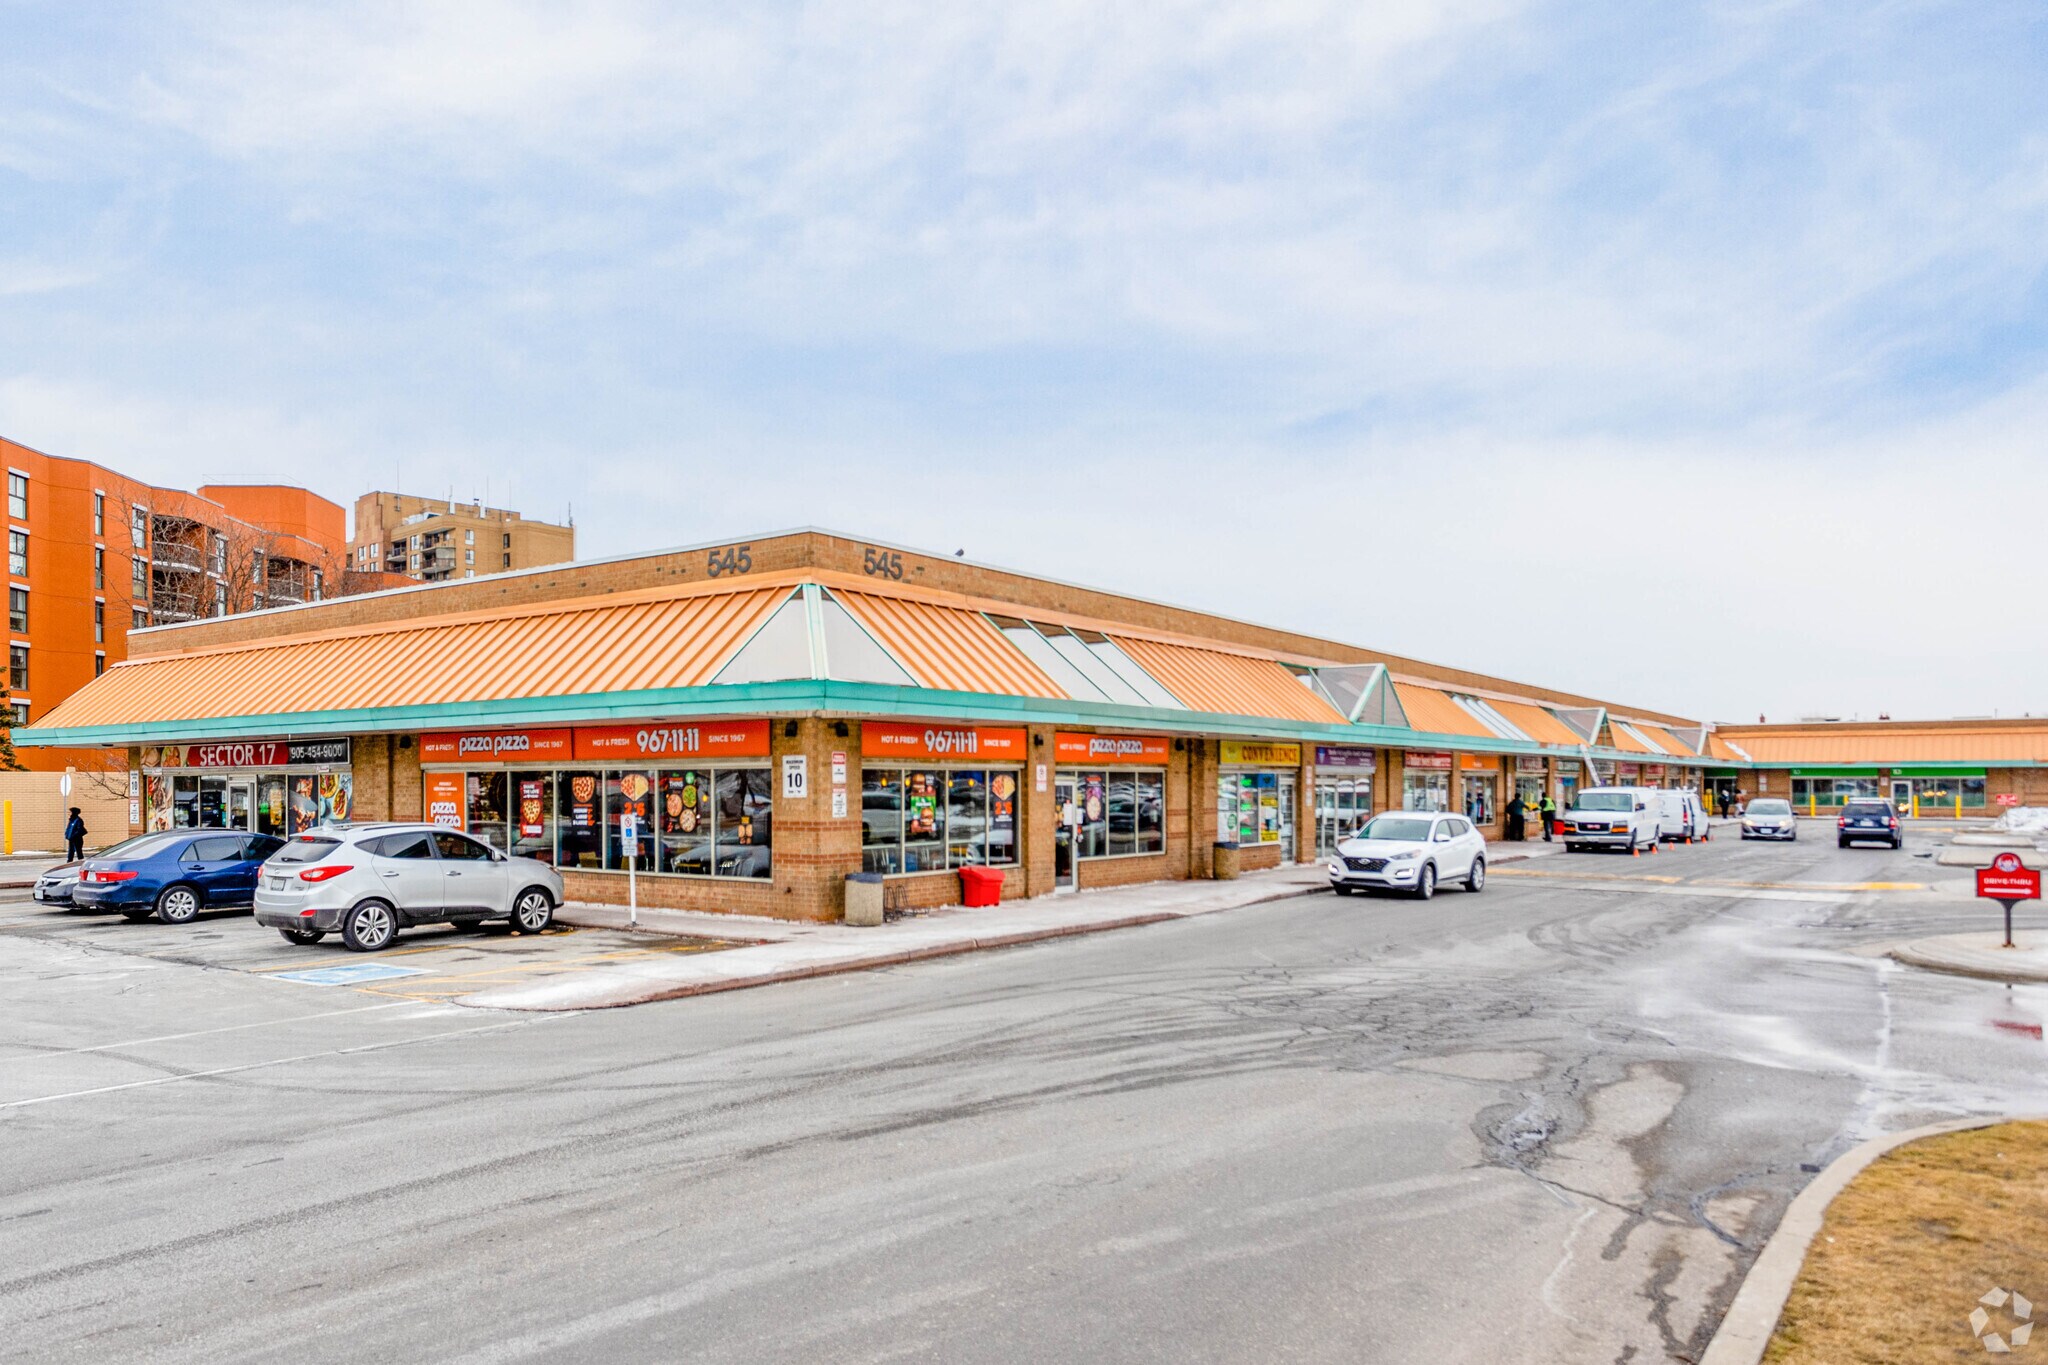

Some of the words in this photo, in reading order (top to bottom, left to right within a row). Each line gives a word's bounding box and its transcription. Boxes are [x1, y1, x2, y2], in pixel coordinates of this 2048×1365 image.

[707, 546, 752, 577] 545
[864, 548, 903, 580] 545
[459, 737, 492, 757] pizza
[494, 735, 529, 756] pizza
[534, 741, 550, 749] SINCE
[708, 735, 728, 743] SINCE
[730, 734, 745, 742] 1967
[1089, 738, 1116, 758] pizza
[1117, 740, 1142, 758] pizza
[200, 745, 254, 766] SECTOR
[259, 744, 276, 765] 17
[1242, 746, 1297, 762] CONVENIENCE
[787, 773, 802, 787] 10
